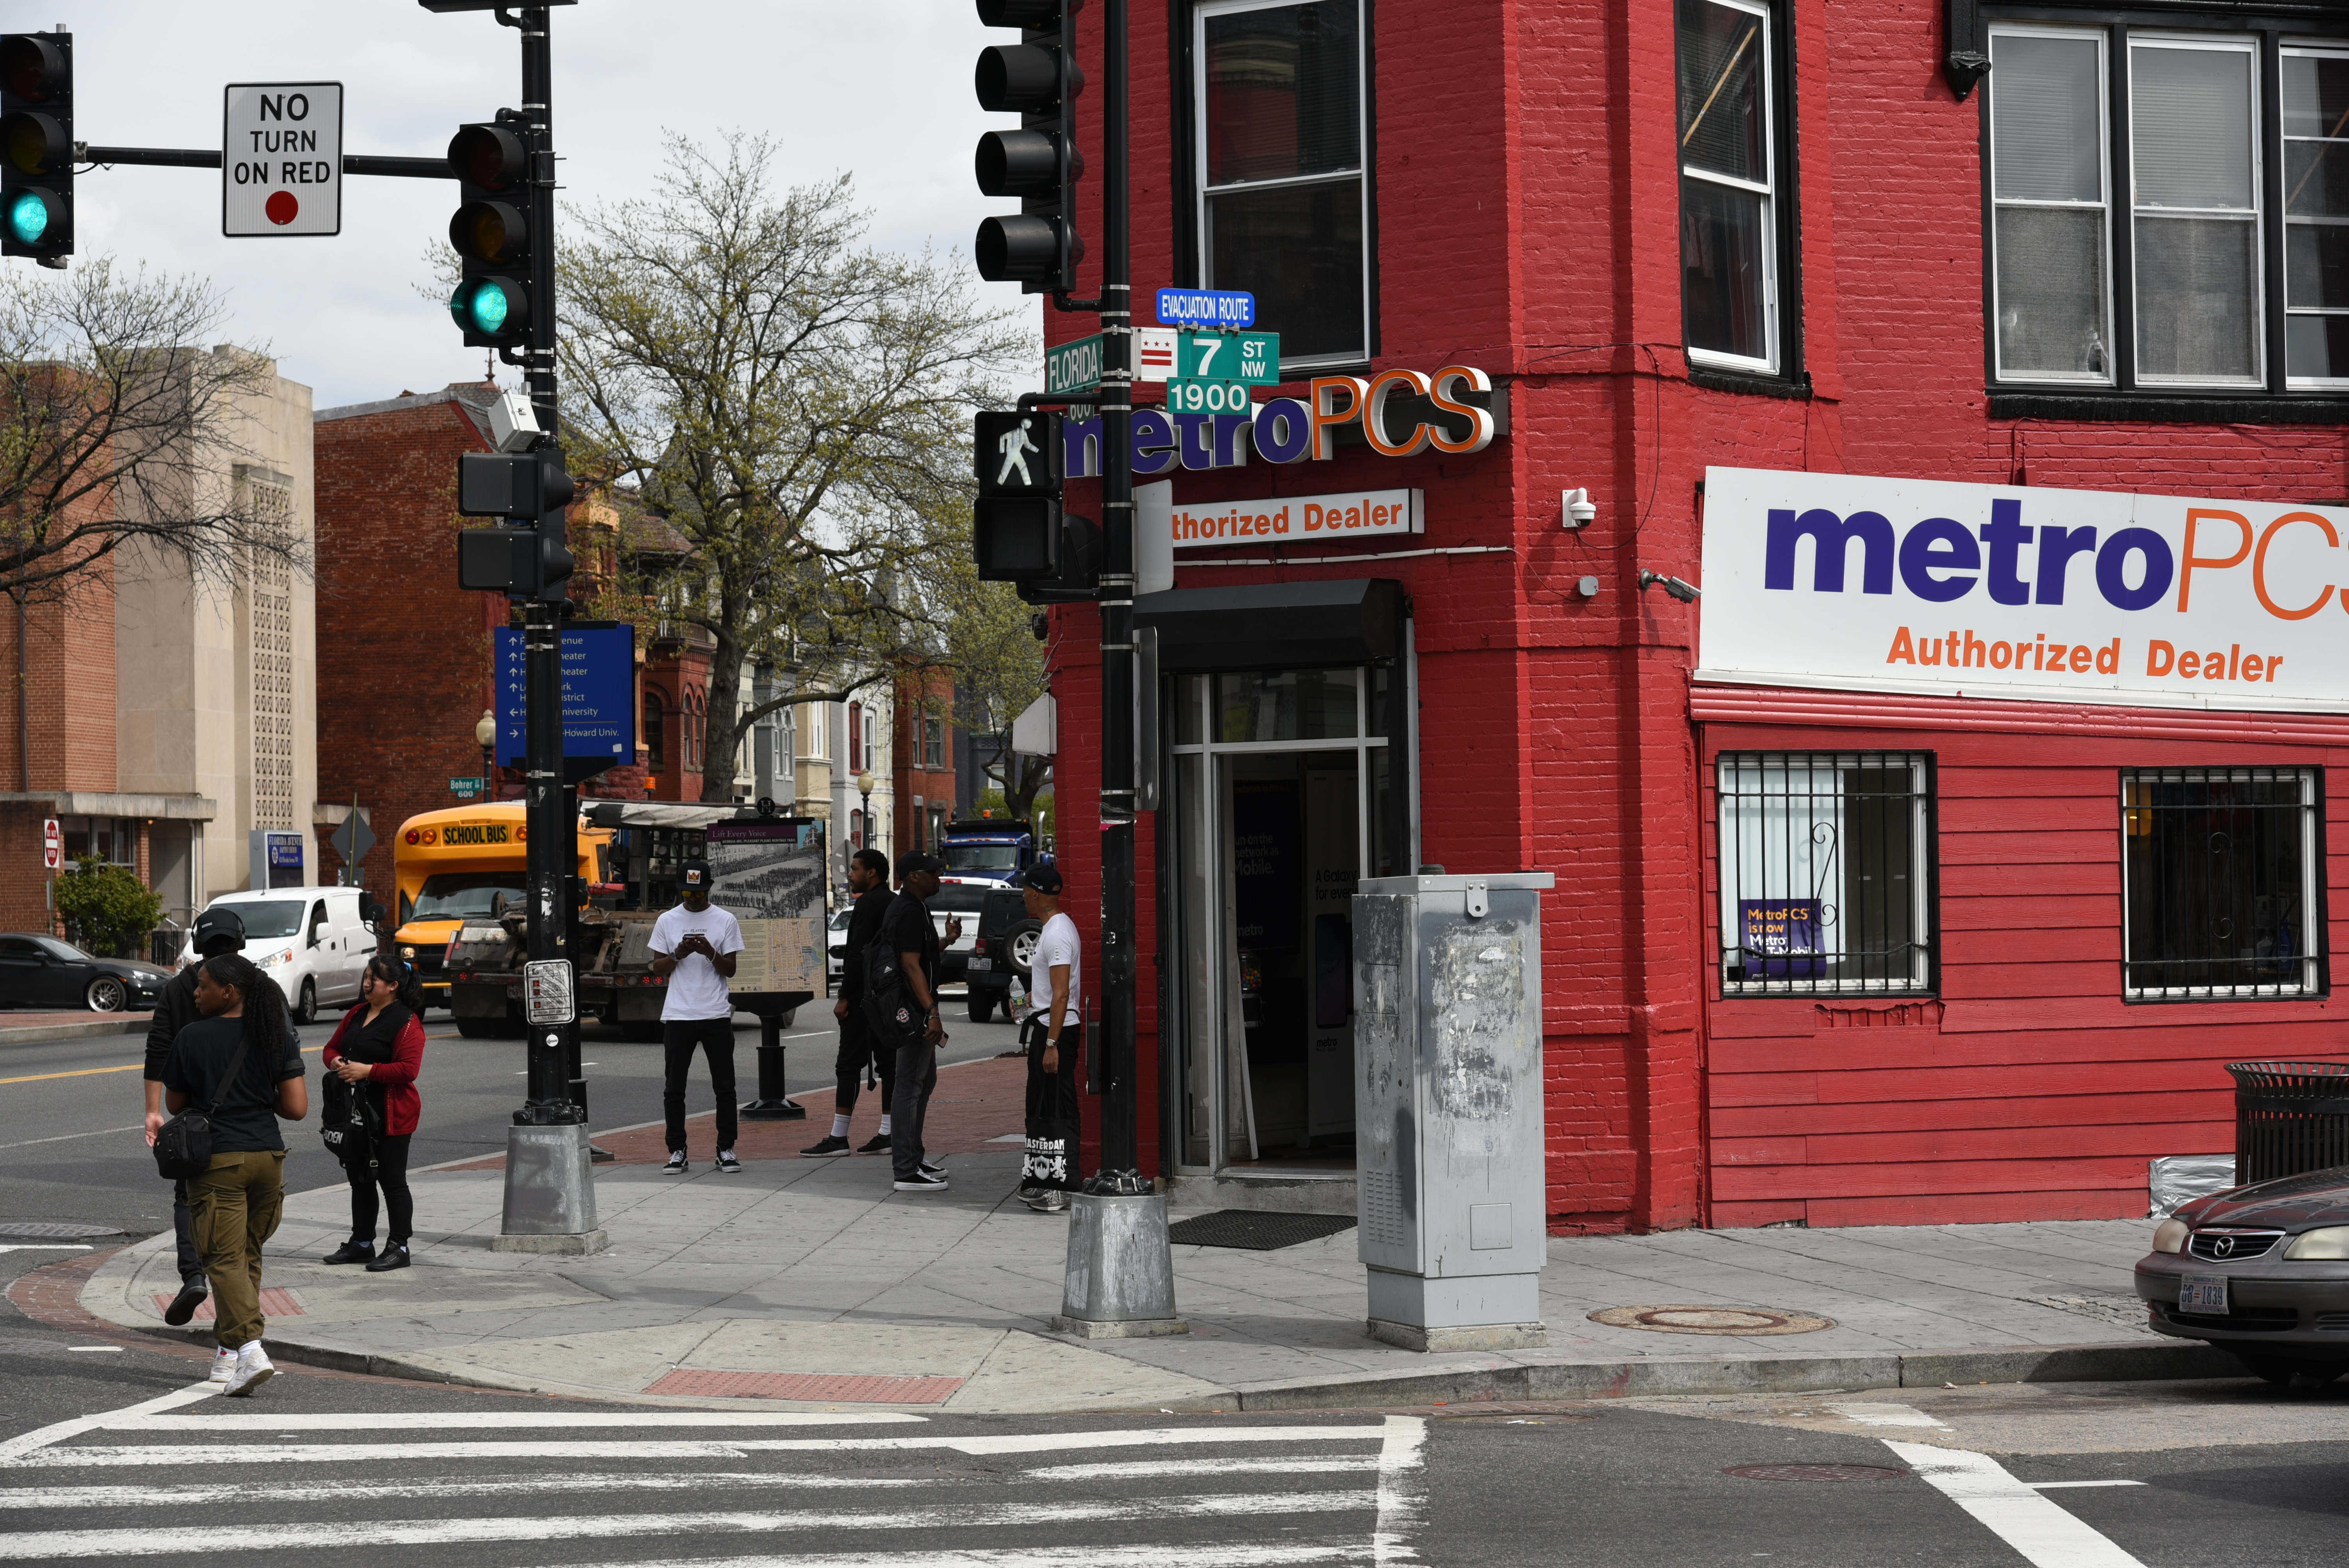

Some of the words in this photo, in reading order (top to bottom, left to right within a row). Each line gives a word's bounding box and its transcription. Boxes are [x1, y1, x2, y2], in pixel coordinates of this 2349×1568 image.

[260, 93, 309, 121] NO
[250, 130, 316, 153] TURN
[234, 162, 268, 184] ON
[282, 161, 330, 184] RED
[1162, 295, 1216, 319] EVACUATION
[1219, 297, 1249, 321] ROUTE
[1193, 339, 1222, 376] 7
[1242, 341, 1265, 358] ST
[1050, 342, 1098, 392] FLORIDA
[1242, 361, 1266, 377] NW
[1171, 384, 1246, 411] 1900
[1172, 506, 1289, 540] thorized
[1304, 499, 1403, 532] Dealer
[1764, 499, 2349, 621] metroPC
[1886, 625, 2120, 675] Authorized
[2146, 639, 2284, 683] Dealer
[561, 667, 588, 675] heater
[561, 693, 585, 701] istrict
[562, 707, 598, 717] niversity
[562, 728, 597, 737] -Howard
[599, 728, 619, 736] Univ.
[450, 780, 473, 789] Bohrer
[269, 836, 287, 846] FLORIDA
[287, 836, 302, 846] AVENUE
[444, 827, 485, 844] SCHOOL
[486, 825, 507, 843] BUS
[727, 830, 747, 839] Every
[1235, 836, 1246, 845] un
[1248, 835, 1257, 845] on
[1259, 832, 1273, 844] the
[48, 849, 56, 858] ENTER
[1235, 845, 1269, 858] network
[1270, 847, 1279, 856] as
[1315, 870, 1322, 883] A
[1324, 869, 1357, 886] Galaxy
[1315, 886, 1329, 900] for
[1331, 887, 1358, 900] every
[1236, 923, 1264, 936] metro
[1748, 922, 1757, 933] is
[899, 1010, 907, 1020] 25
[1317, 1037, 1337, 1047] metro
[1025, 1138, 1064, 1150] ASTERDAM
[2182, 1284, 2194, 1303] DB
[2201, 1285, 2223, 1305] 1839
